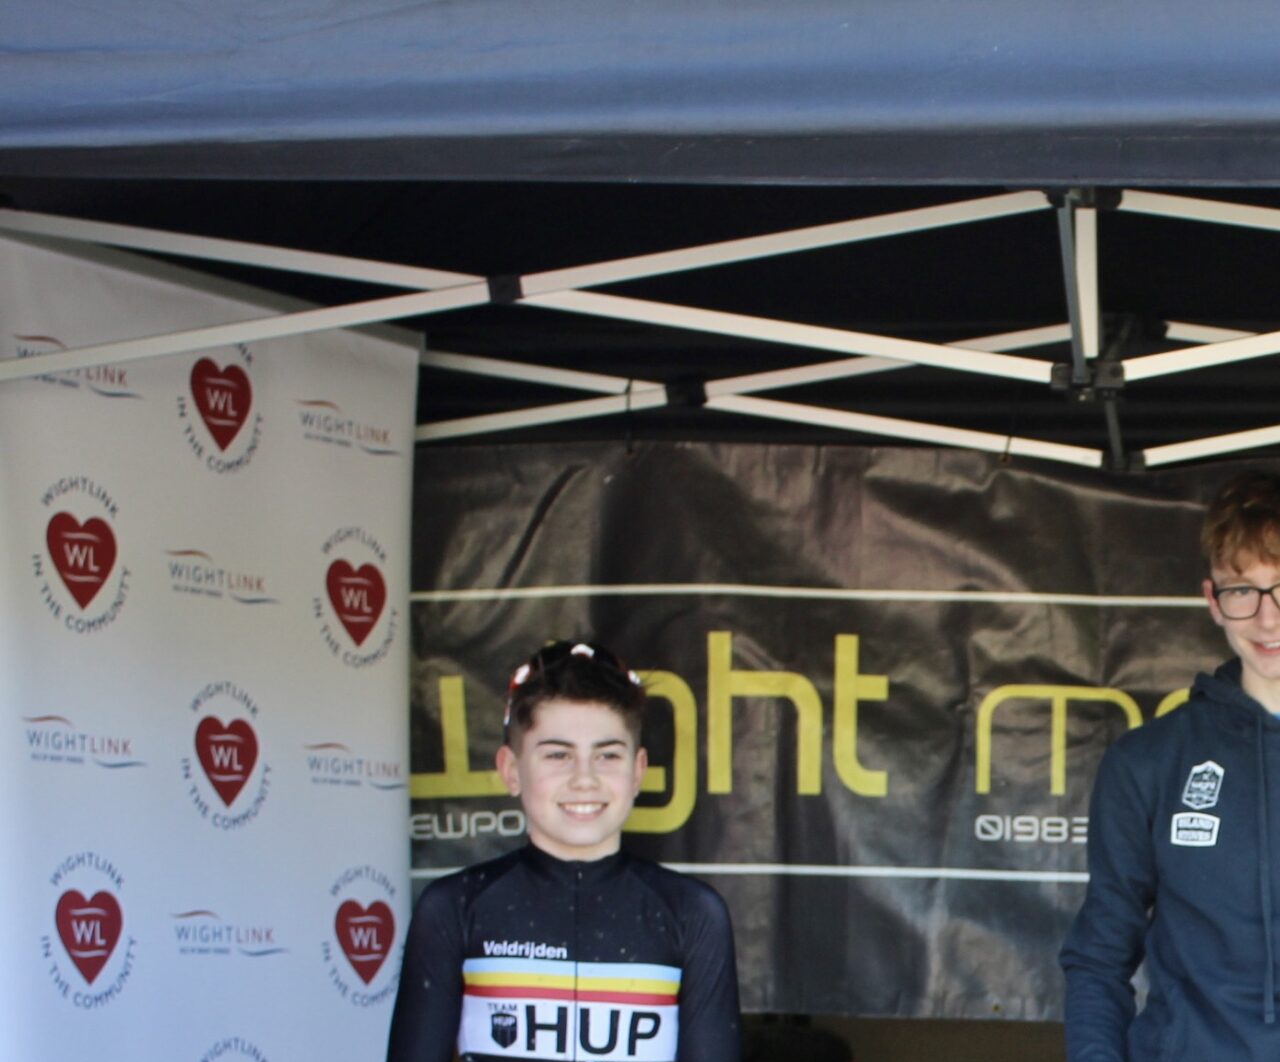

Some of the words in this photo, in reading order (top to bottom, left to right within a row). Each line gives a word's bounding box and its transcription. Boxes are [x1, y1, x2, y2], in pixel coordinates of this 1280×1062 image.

[206, 387, 237, 416] WL
[301, 412, 391, 444] WIGHTLINK
[64, 543, 100, 572] WL
[168, 561, 265, 593] WIGHTLINK
[340, 587, 372, 613] WL
[27, 729, 132, 755] WIGHTLINK
[211, 745, 243, 771] WL
[72, 920, 106, 945] WL
[175, 924, 274, 944] WIGHTLINK
[350, 928, 382, 950] WL
[483, 940, 568, 959] Veldrijden
[525, 1004, 661, 1056] HUP
